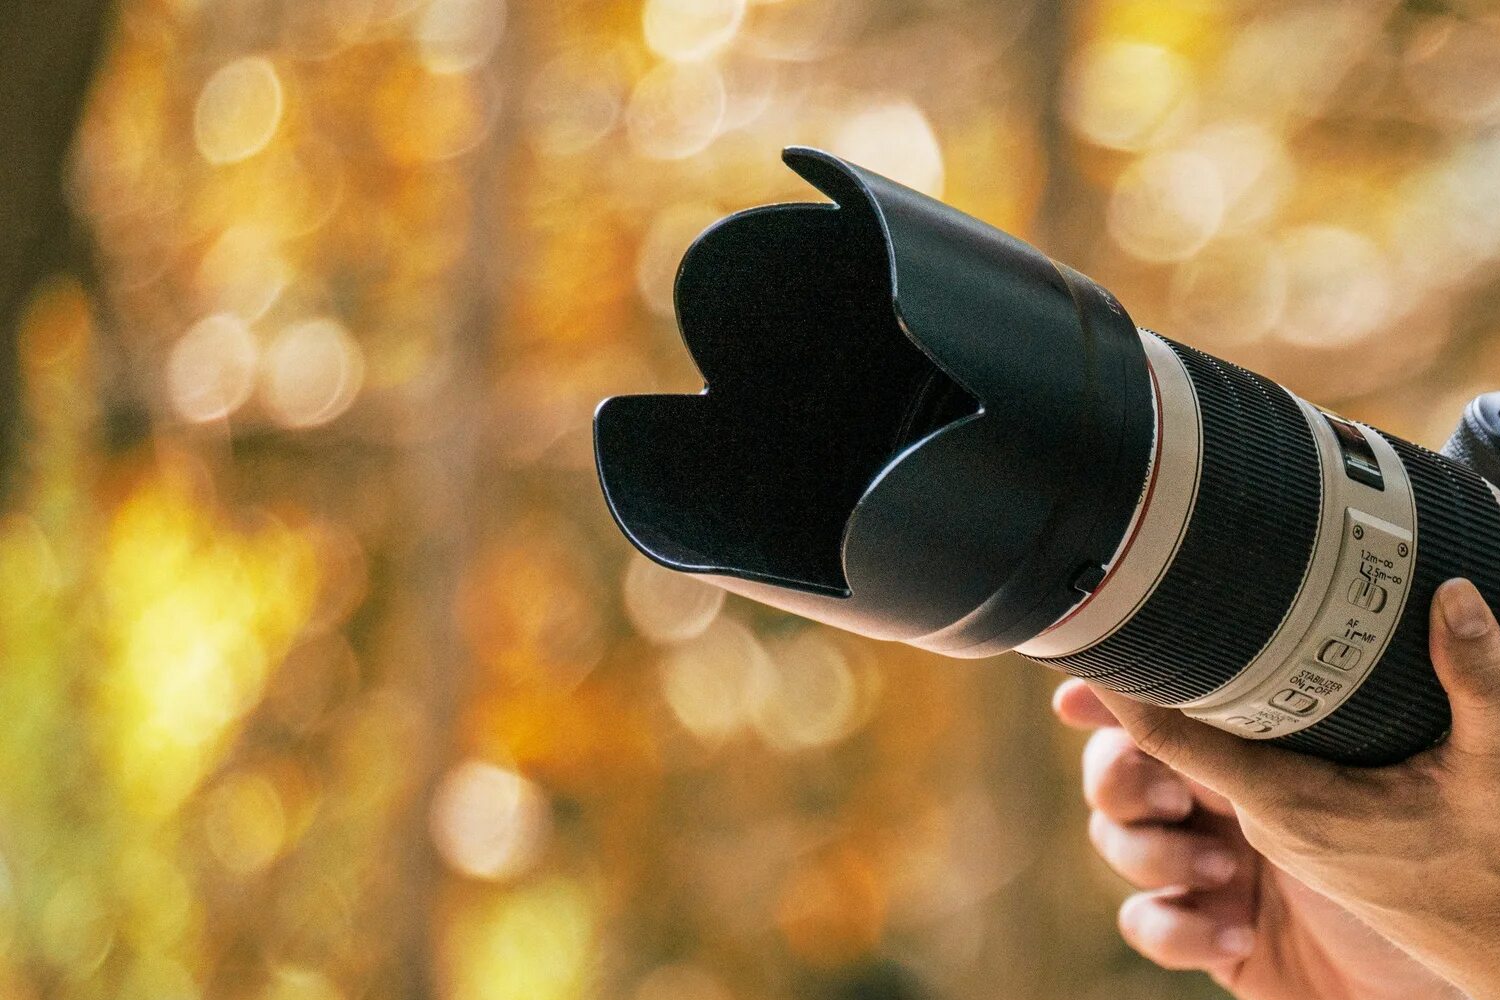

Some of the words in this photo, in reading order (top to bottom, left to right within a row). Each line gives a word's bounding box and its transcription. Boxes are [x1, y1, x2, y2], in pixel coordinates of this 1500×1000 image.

[1346, 618, 1360, 628] AF
[1362, 631, 1377, 643] MF
[1289, 675, 1305, 687] ON
[1314, 685, 1333, 696] OFF
[1298, 669, 1343, 692] STABILIZER
